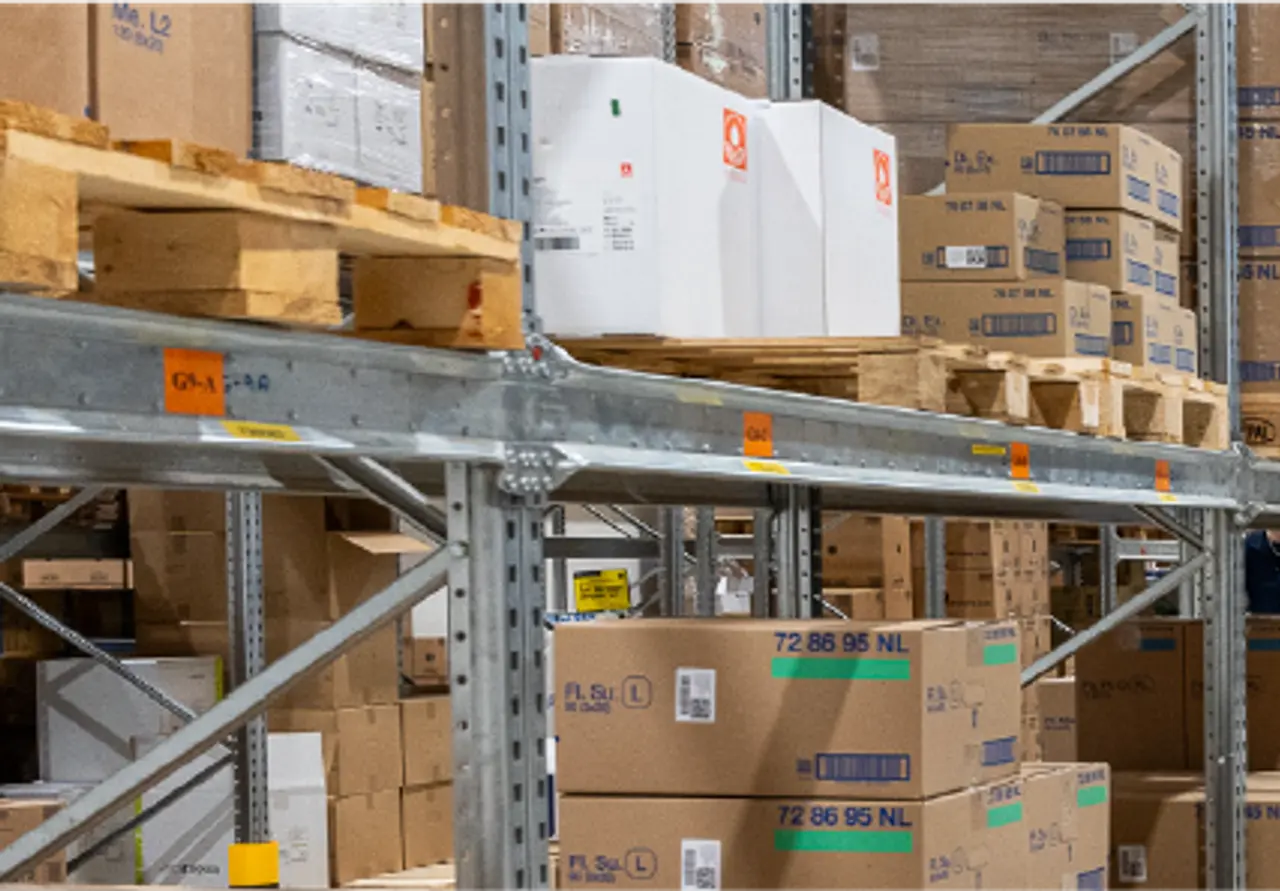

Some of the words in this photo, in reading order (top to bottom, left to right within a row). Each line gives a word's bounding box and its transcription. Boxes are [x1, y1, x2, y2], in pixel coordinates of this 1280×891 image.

[1257, 265, 1280, 280] NL
[774, 632, 801, 652] 72
[806, 633, 836, 653] 86
[842, 633, 869, 653] 95
[877, 634, 909, 653] NL
[778, 806, 804, 826] 72
[810, 807, 838, 826] 86
[844, 808, 872, 827] 95
[878, 808, 912, 827] NL
